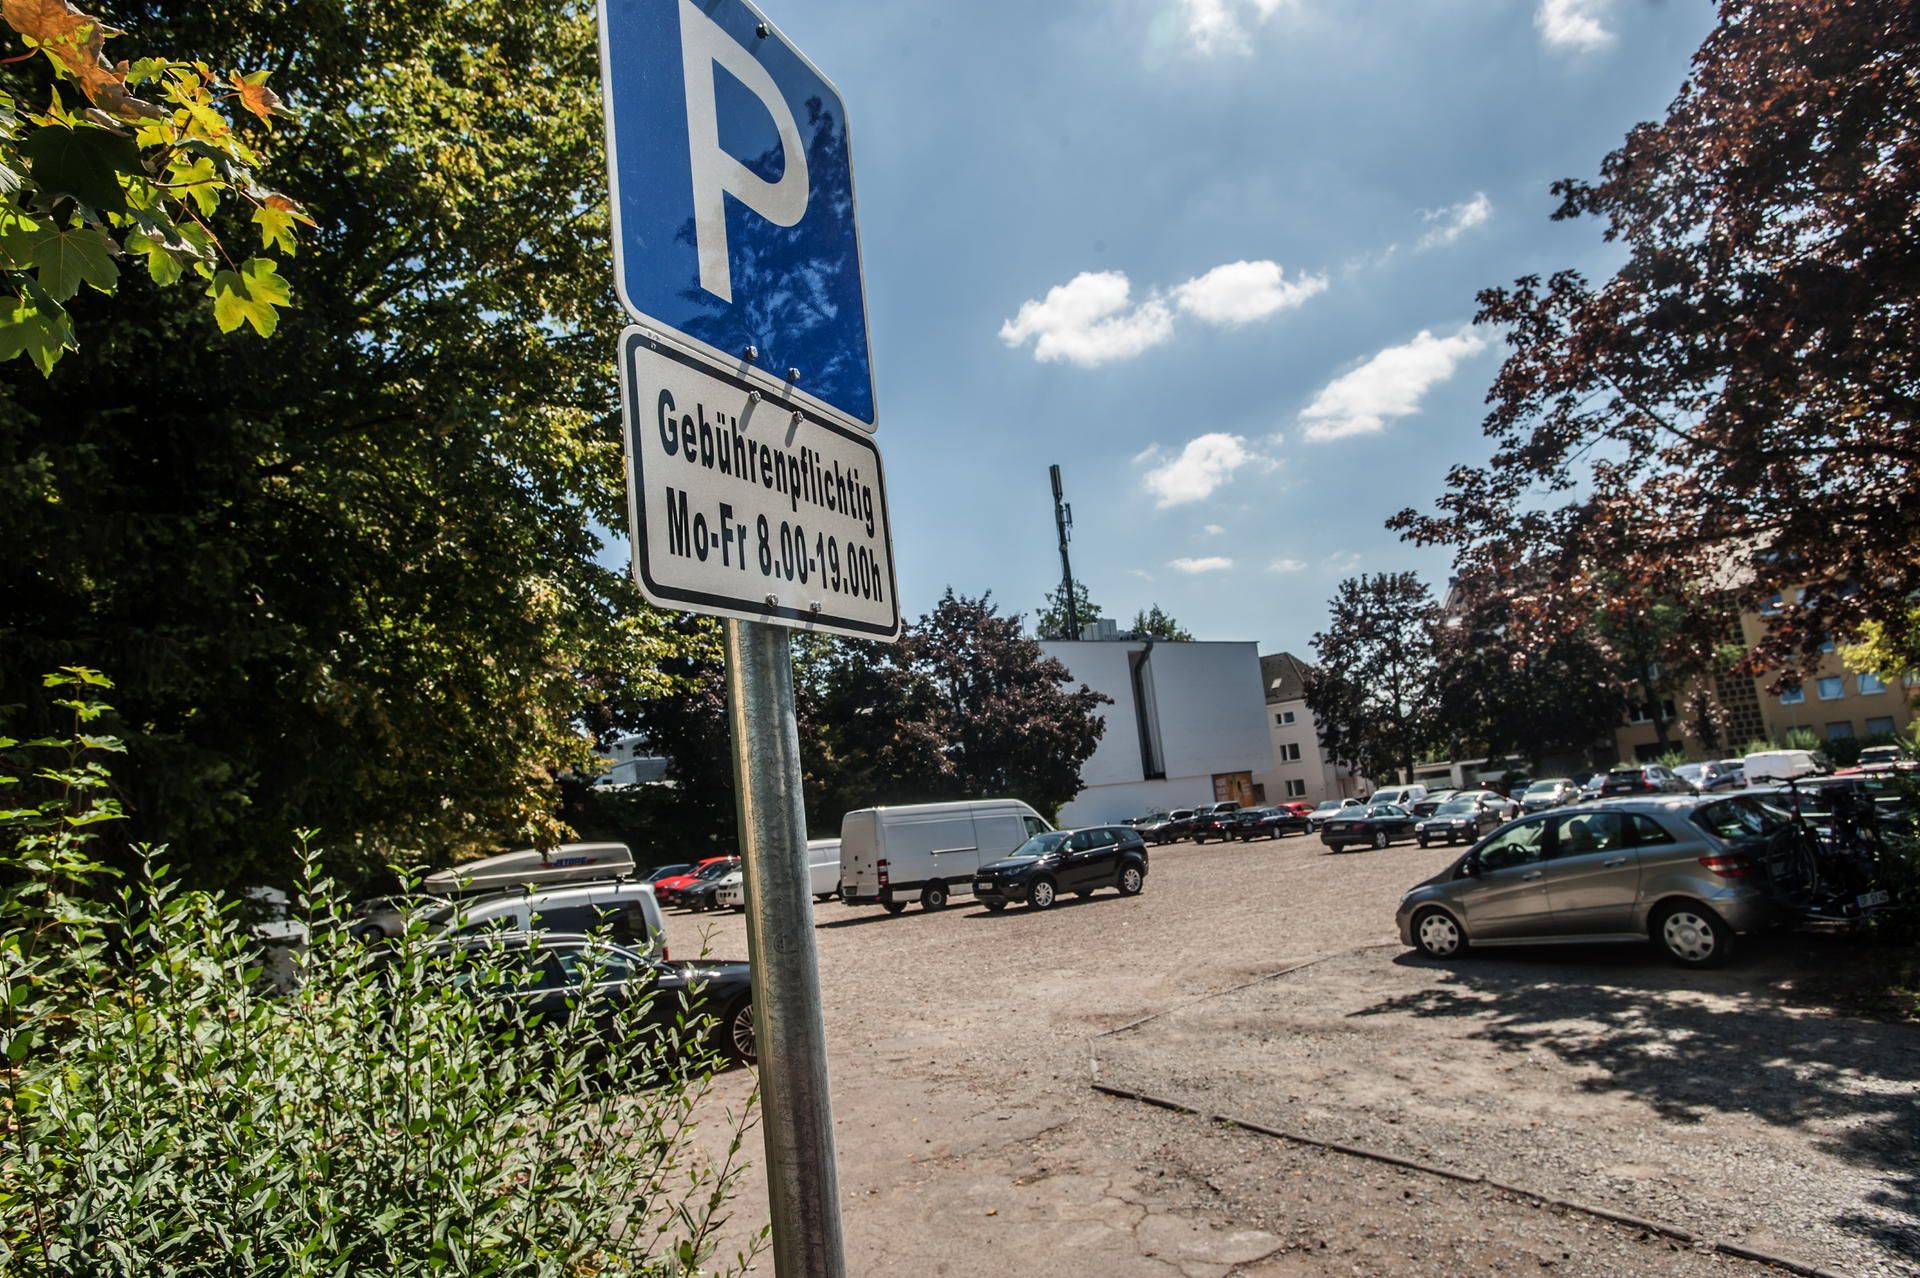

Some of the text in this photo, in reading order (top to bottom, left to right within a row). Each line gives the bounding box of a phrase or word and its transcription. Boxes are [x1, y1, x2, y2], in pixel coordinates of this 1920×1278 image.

[677, 0, 809, 304] P
[657, 388, 875, 539] Gebührenpflichtig
[665, 486, 883, 603] Mo-Fr 8.00-19.00h
